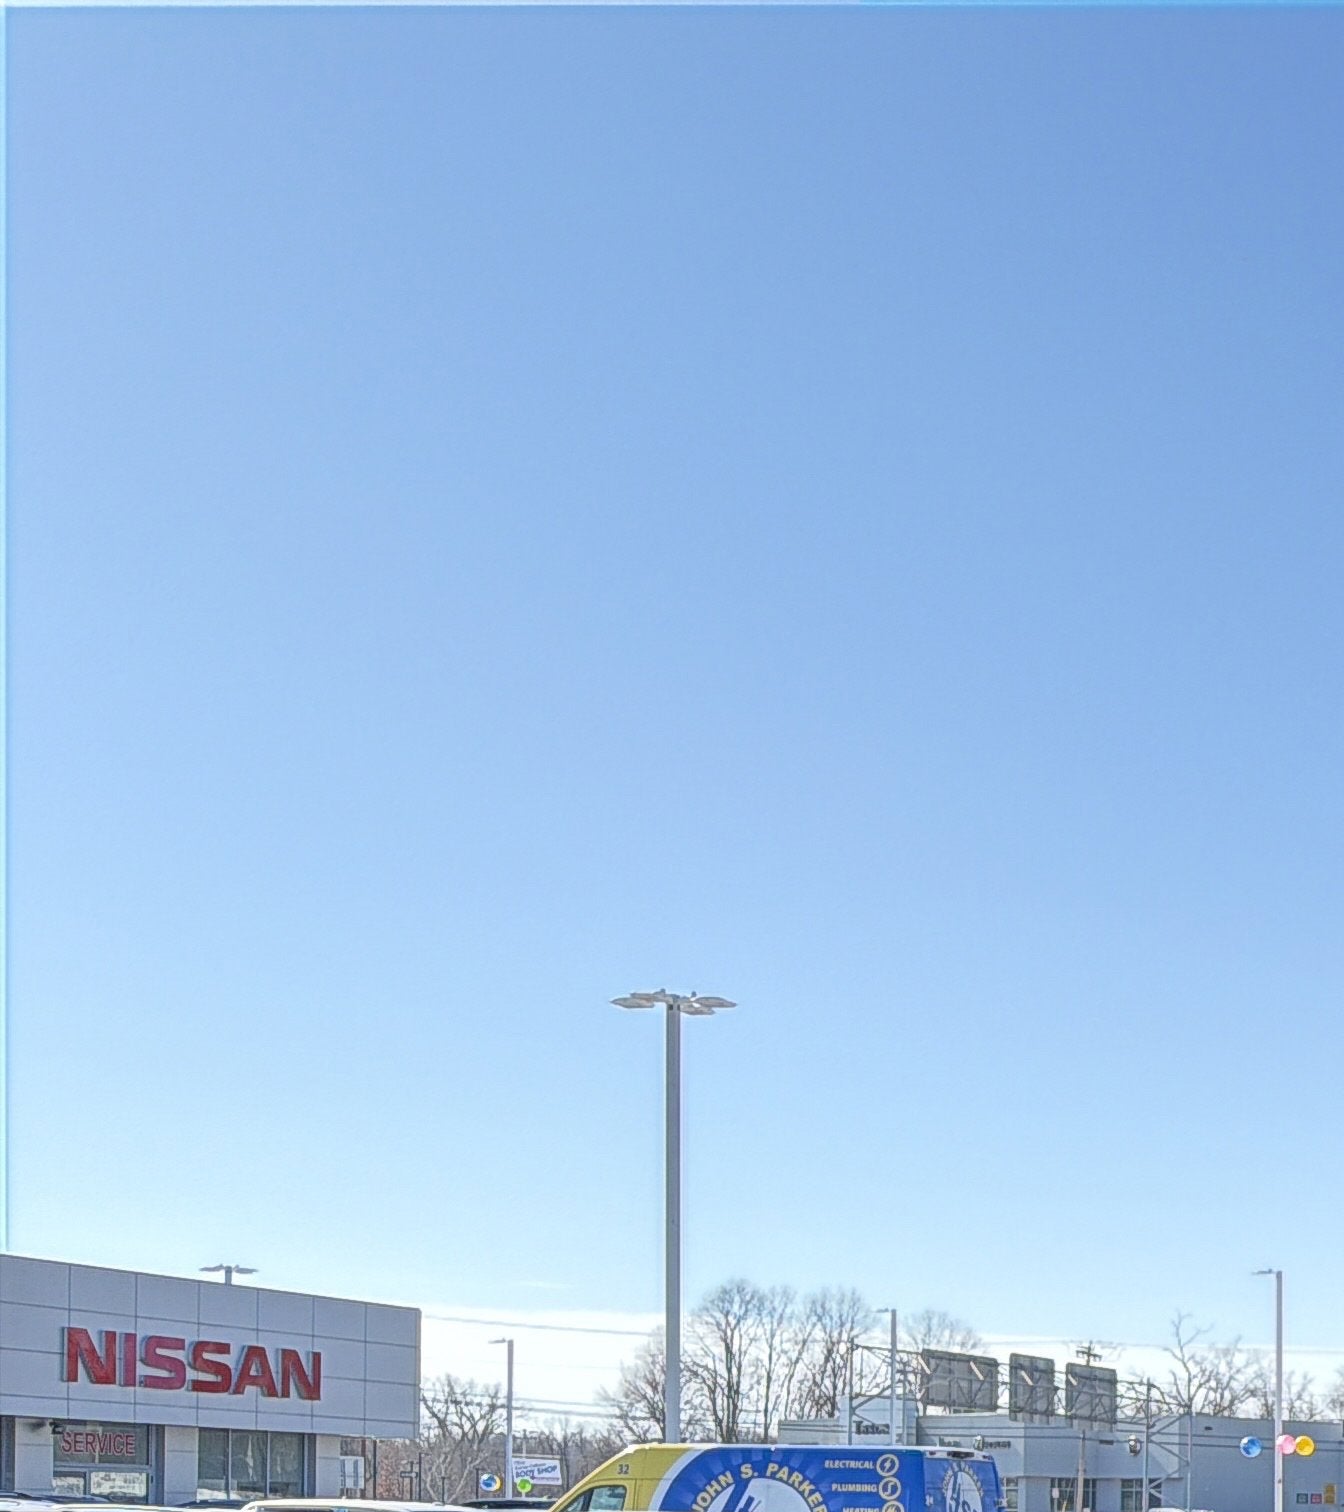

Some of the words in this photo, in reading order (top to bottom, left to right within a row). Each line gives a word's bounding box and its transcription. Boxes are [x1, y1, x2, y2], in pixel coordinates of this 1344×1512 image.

[63, 1326, 322, 1401] NISSAN
[61, 1431, 136, 1457] SERVICE
[740, 1463, 759, 1479] S.
[824, 1459, 875, 1470] ELECTRICAL
[831, 1482, 878, 1493] PLUMBING
